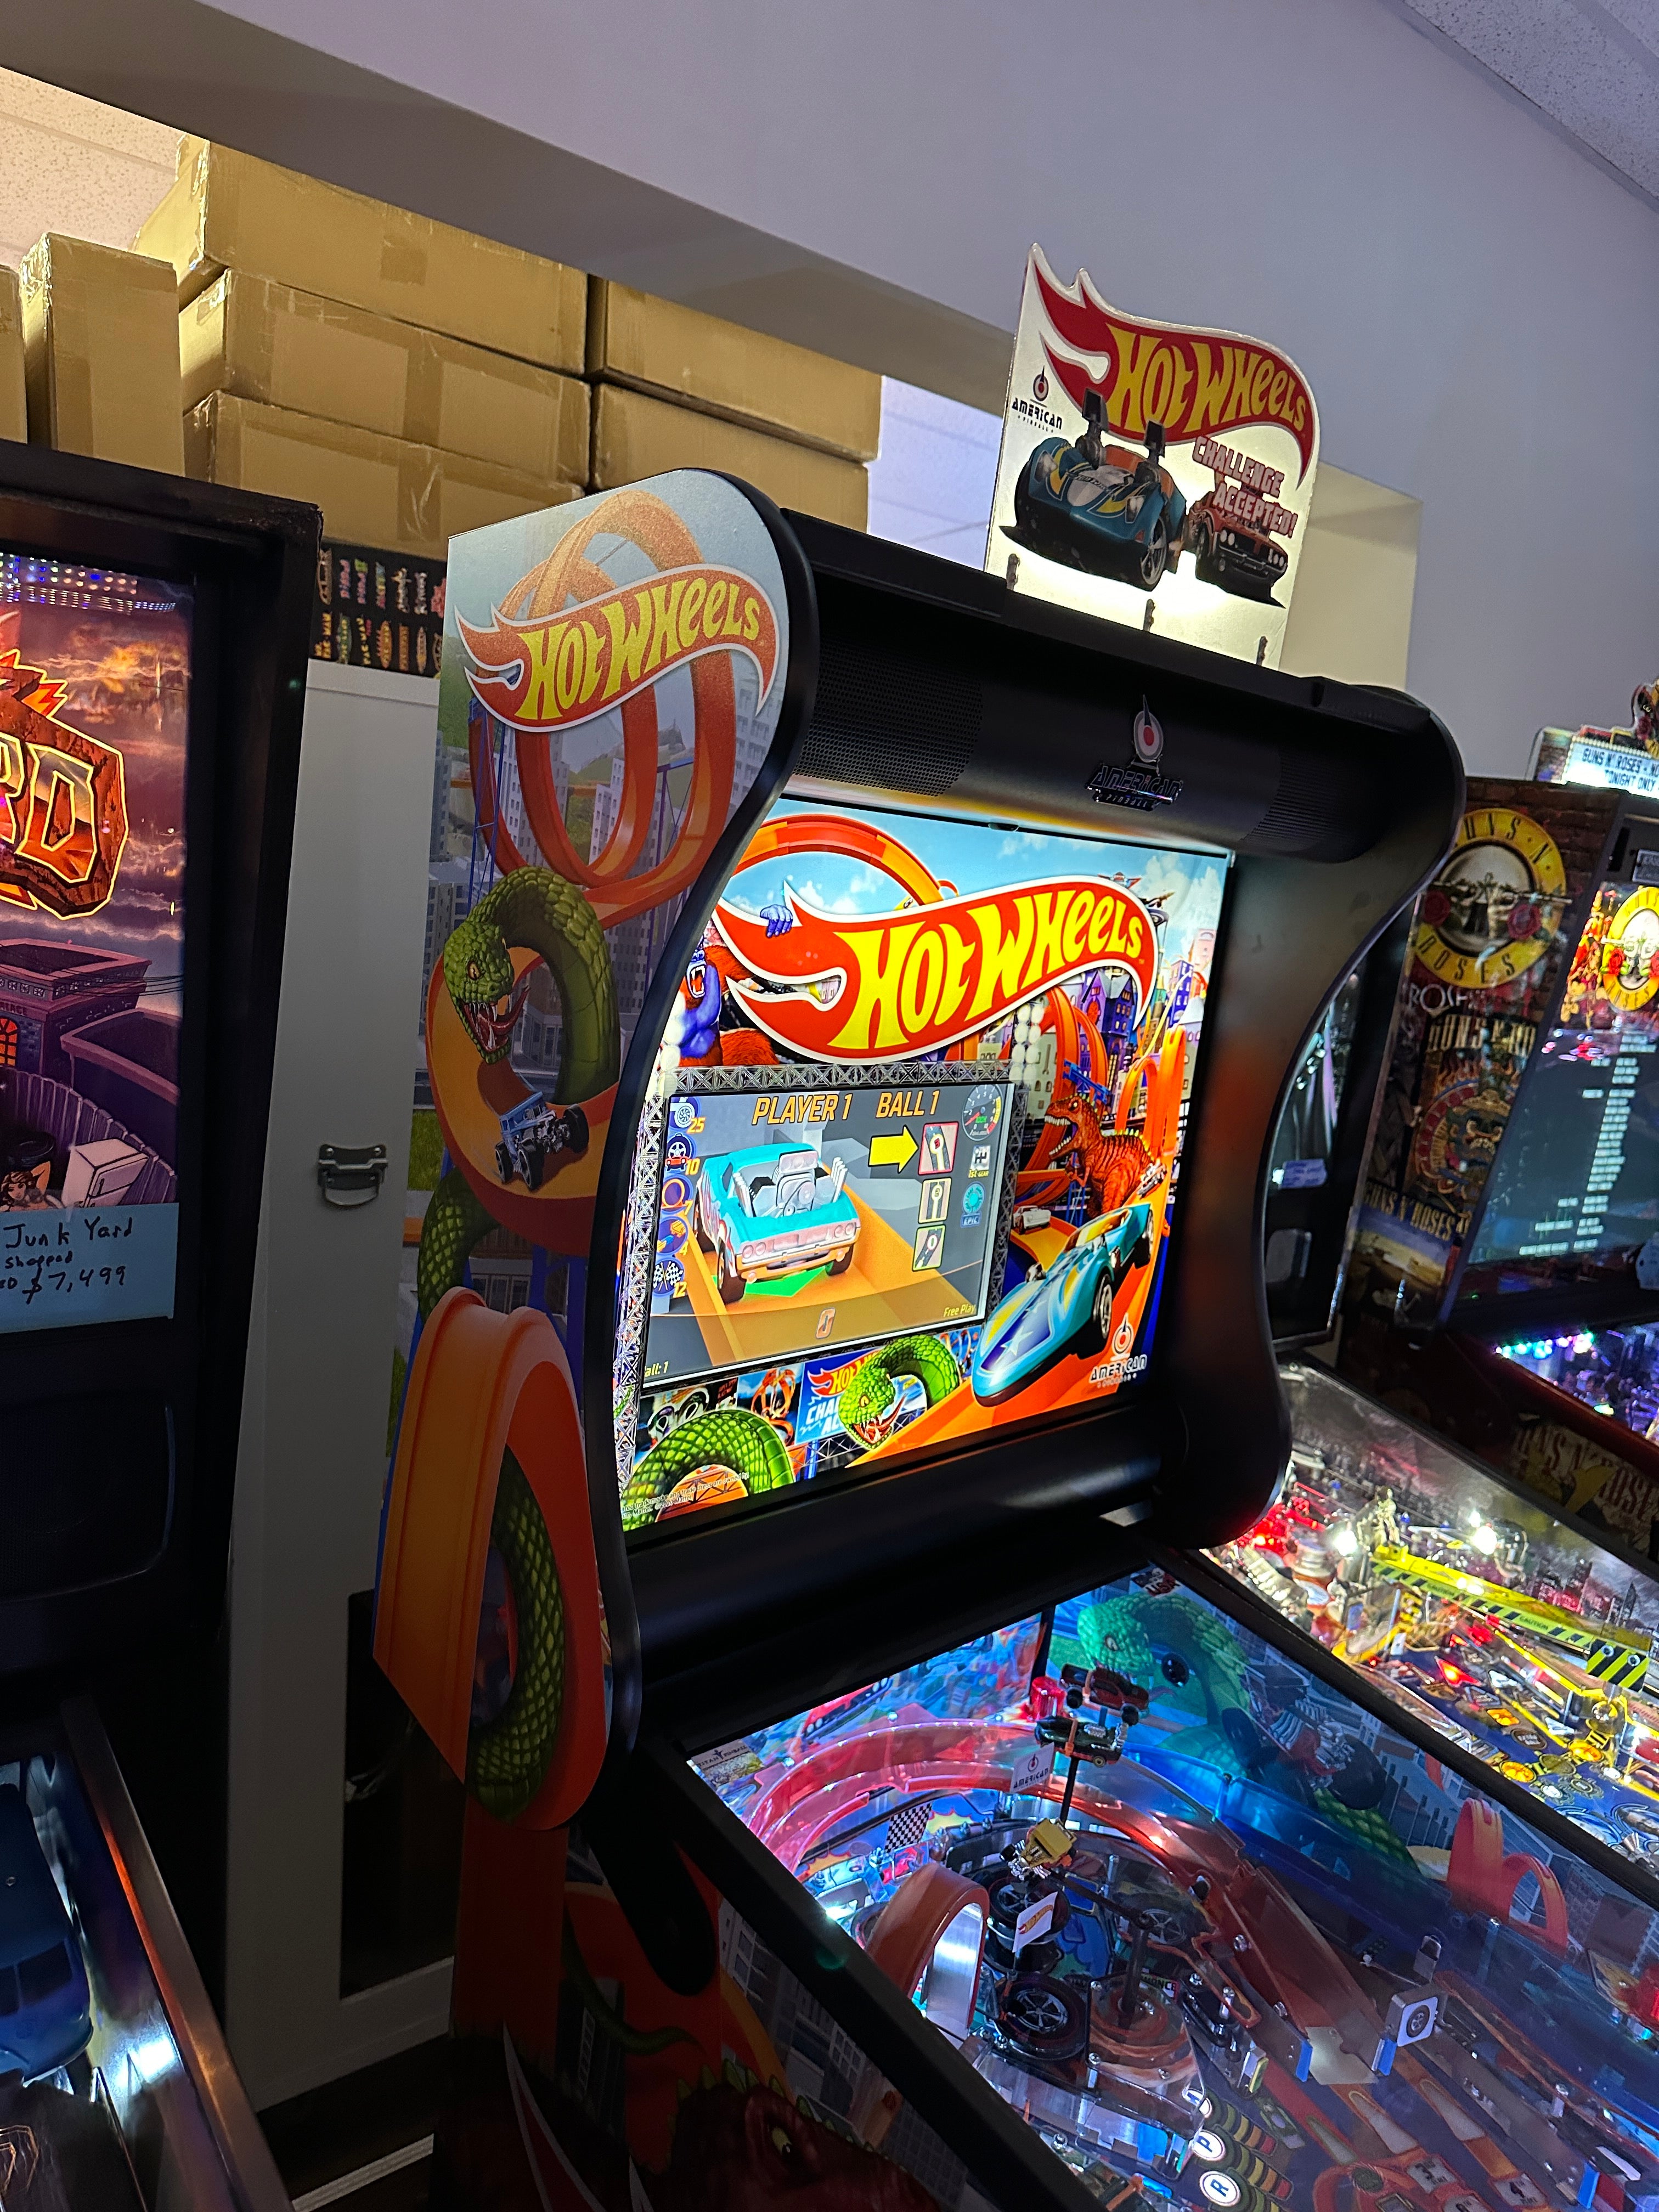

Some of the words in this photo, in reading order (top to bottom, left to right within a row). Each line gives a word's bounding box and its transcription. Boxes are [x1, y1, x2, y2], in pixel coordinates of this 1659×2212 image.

[1012, 397, 1063, 430] AMERICAN
[1192, 436, 1285, 499] CHALLENGE
[1212, 481, 1299, 539] ACCEPTED!
[1582, 748, 1605, 765] GUNS
[1616, 755, 1642, 773] ROSES
[1090, 765, 1183, 799] AMERICAN
[1605, 769, 1636, 786] TONIGHT
[1637, 776, 1656, 792] ONLY
[752, 1094, 839, 1125] PLAYER
[842, 1093, 853, 1120] 1
[876, 1090, 925, 1119] BALL
[930, 1090, 940, 1115] 1
[687, 1118, 706, 1133] 25
[685, 1158, 700, 1175] 10
[684, 1200, 693, 1216] 7
[3, 1222, 70, 1249] Junk
[84, 1215, 133, 1240] Yard
[963, 1216, 979, 1225] EPIC
[680, 1242, 689, 1256] 4
[673, 1282, 687, 1298] 12
[944, 1306, 958, 1317] Free
[960, 1304, 975, 1315] Play
[645, 1363, 662, 1378] all:
[1088, 1354, 1148, 1384] AMERICAN
[636, 1493, 668, 1508] trademarks
[681, 1486, 696, 1496] trade
[697, 1482, 712, 1491] dress
[723, 1473, 741, 1483] owned
[697, 1756, 719, 1767] TITAN
